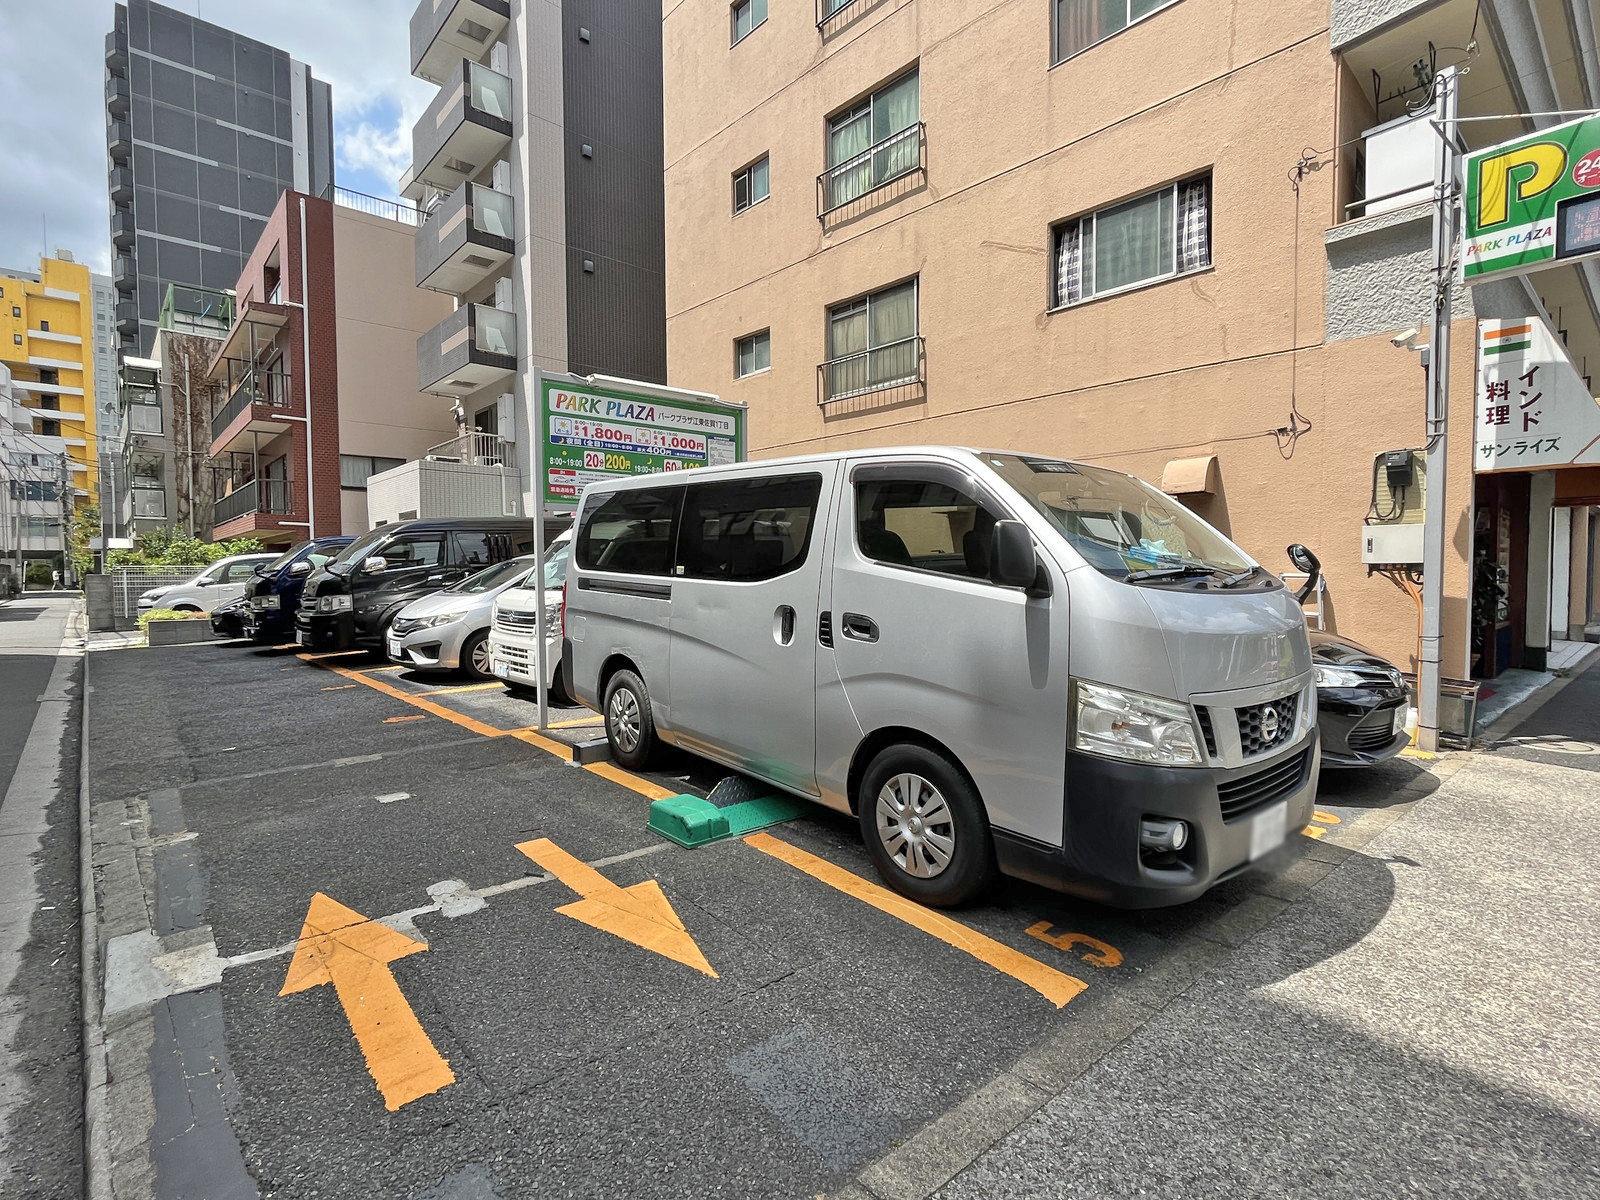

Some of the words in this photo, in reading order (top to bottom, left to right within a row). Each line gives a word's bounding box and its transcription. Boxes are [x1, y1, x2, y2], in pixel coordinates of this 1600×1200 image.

[1478, 142, 1568, 229] P
[1467, 238, 1502, 257] PARK
[1506, 226, 1552, 247] PLAZA
[555, 393, 602, 414] PARK
[605, 400, 656, 422] PLAZA
[1485, 379, 1511, 426] 料理
[1518, 365, 1543, 433] インド
[581, 426, 633, 442] 1,800円
[660, 435, 704, 450] 1,000円
[1481, 436, 1562, 459] サンライズ
[605, 454, 631, 470] 200円
[1024, 920, 1125, 968] 5
